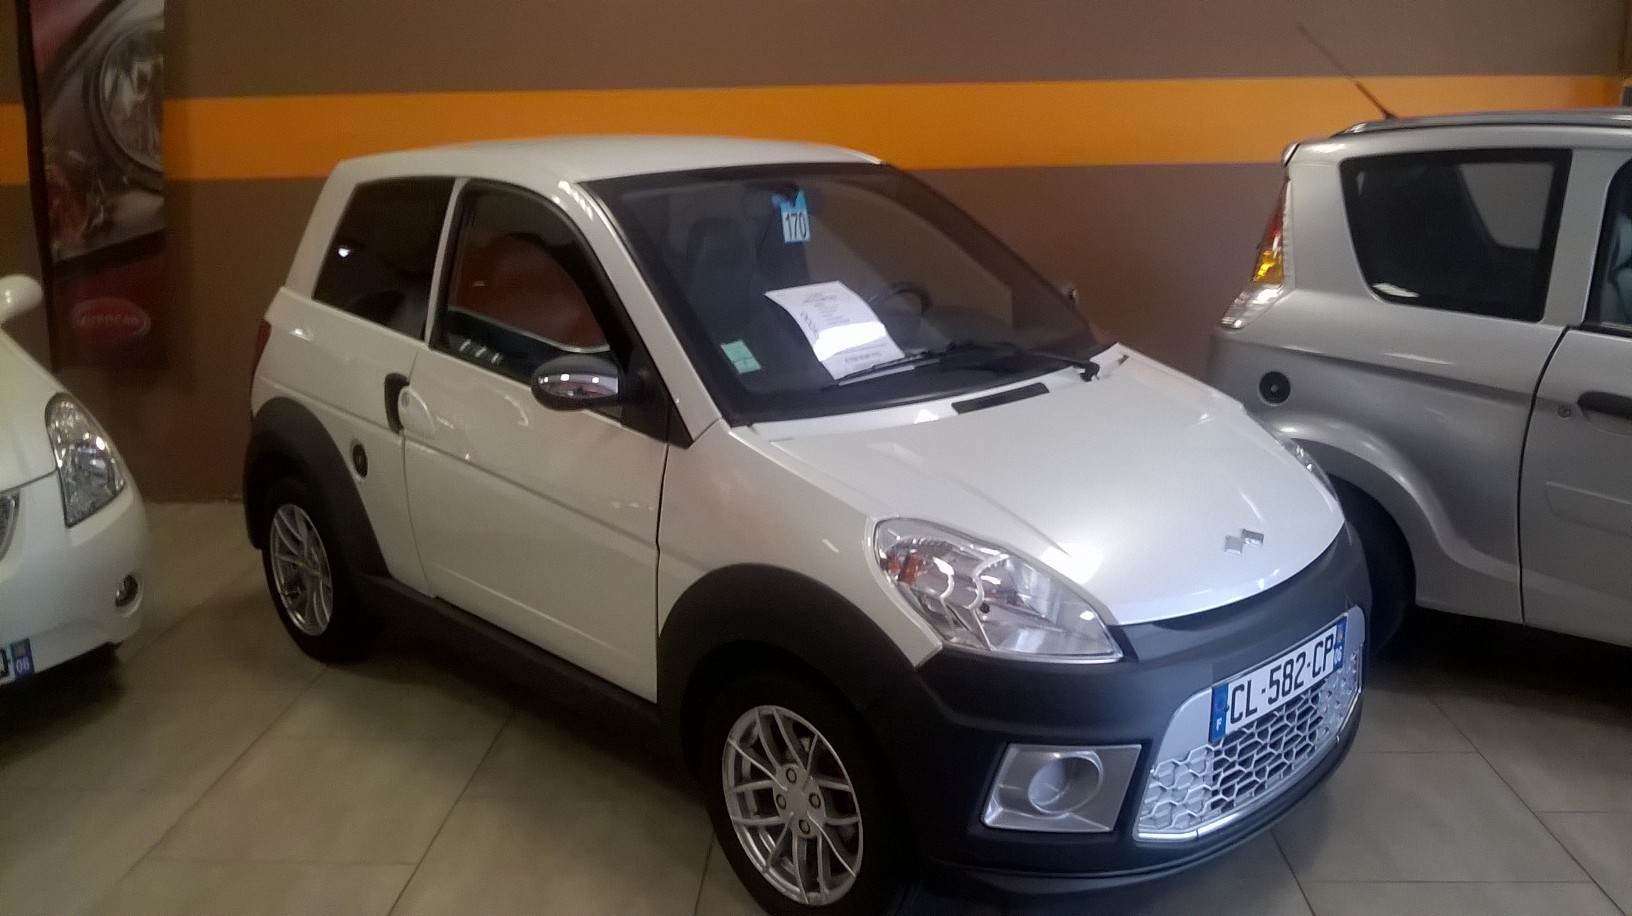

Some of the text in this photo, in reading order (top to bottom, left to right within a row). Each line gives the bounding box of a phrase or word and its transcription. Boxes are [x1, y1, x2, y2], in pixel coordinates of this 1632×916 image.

[786, 213, 807, 240] 170
[1230, 633, 1334, 724] CL-582-CP
[1216, 717, 1222, 731] F
